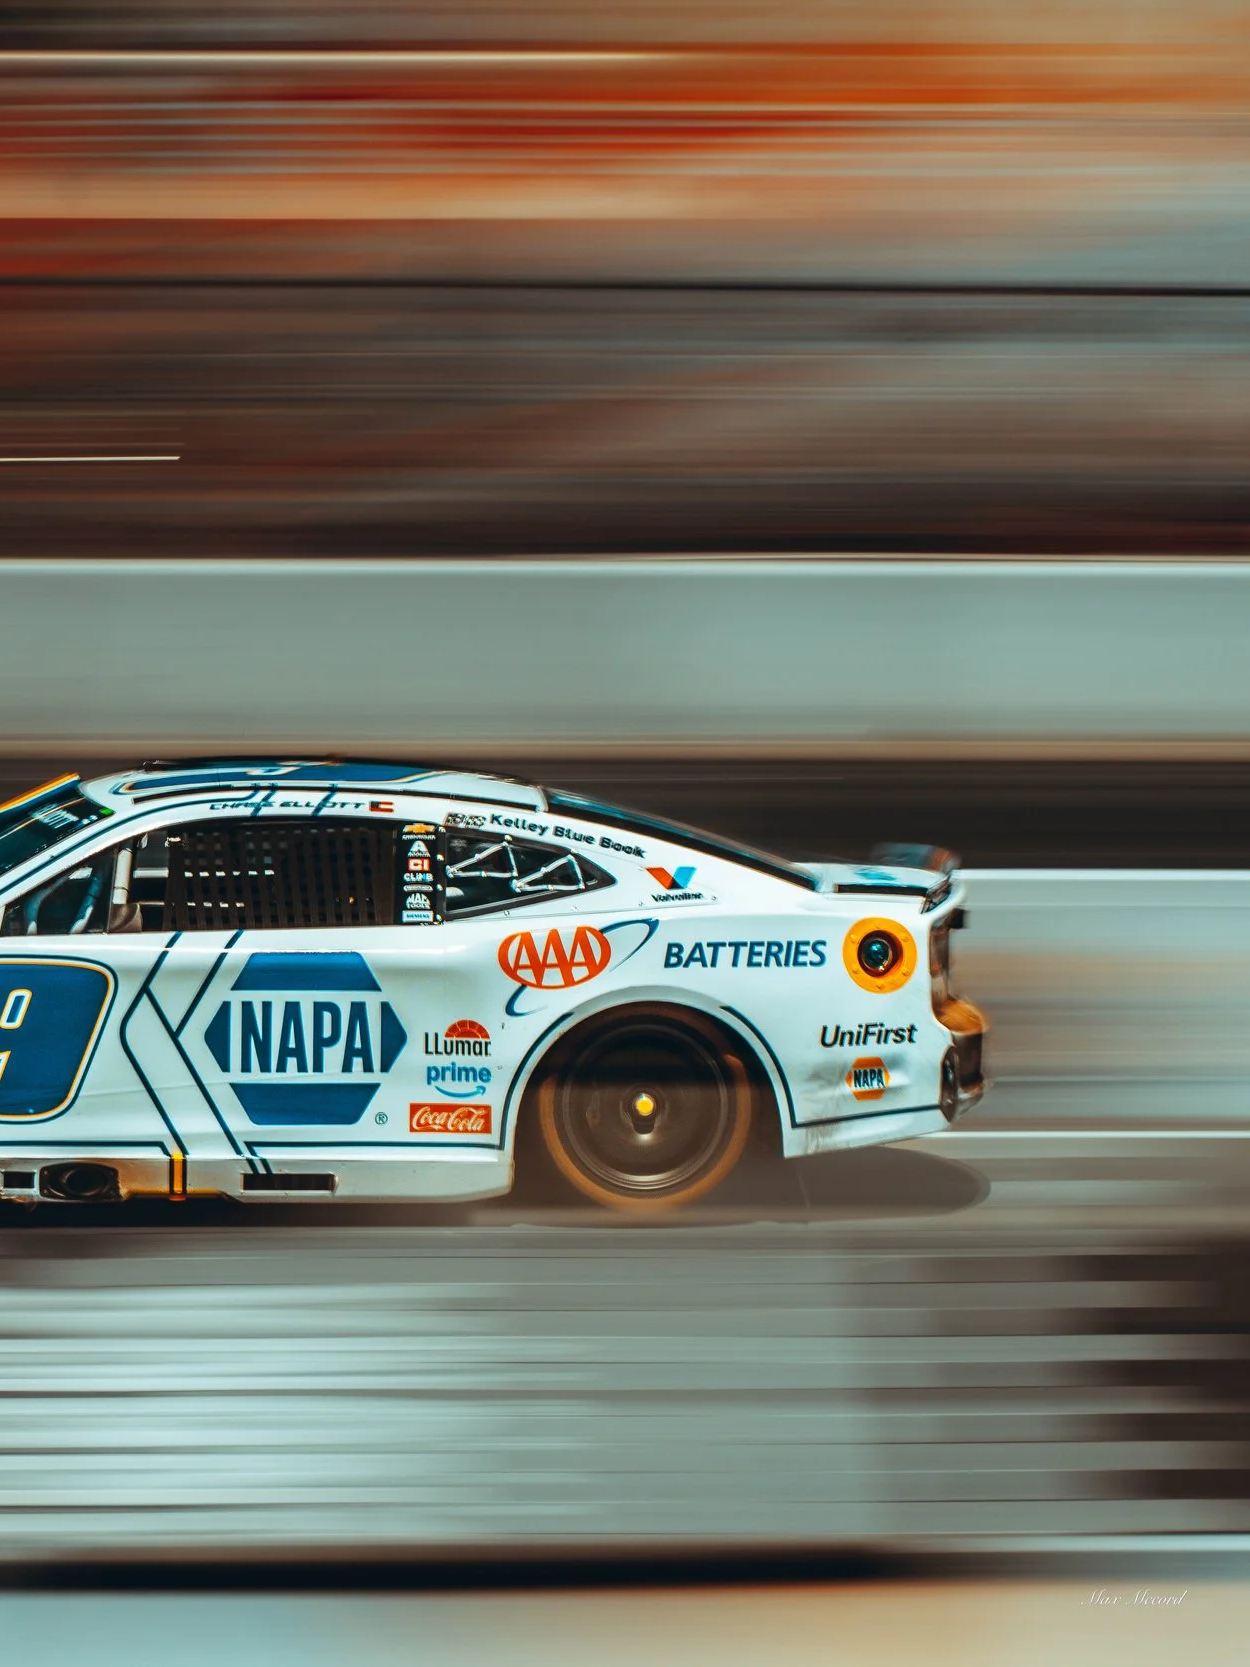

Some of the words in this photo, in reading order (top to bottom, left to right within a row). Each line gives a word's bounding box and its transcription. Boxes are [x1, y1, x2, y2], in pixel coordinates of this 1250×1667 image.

[279, 801, 366, 810] ELLOTT
[490, 814, 549, 836] Kelley
[552, 826, 596, 844] Blue
[599, 836, 647, 859] Book
[508, 927, 602, 988] AAA
[664, 939, 827, 969] BATTERIES
[240, 1001, 375, 1073] NAPA
[424, 1031, 491, 1057] LLumar
[820, 1022, 918, 1048] UniFirst
[426, 1061, 492, 1085] prime
[853, 1067, 886, 1089] NAPA
